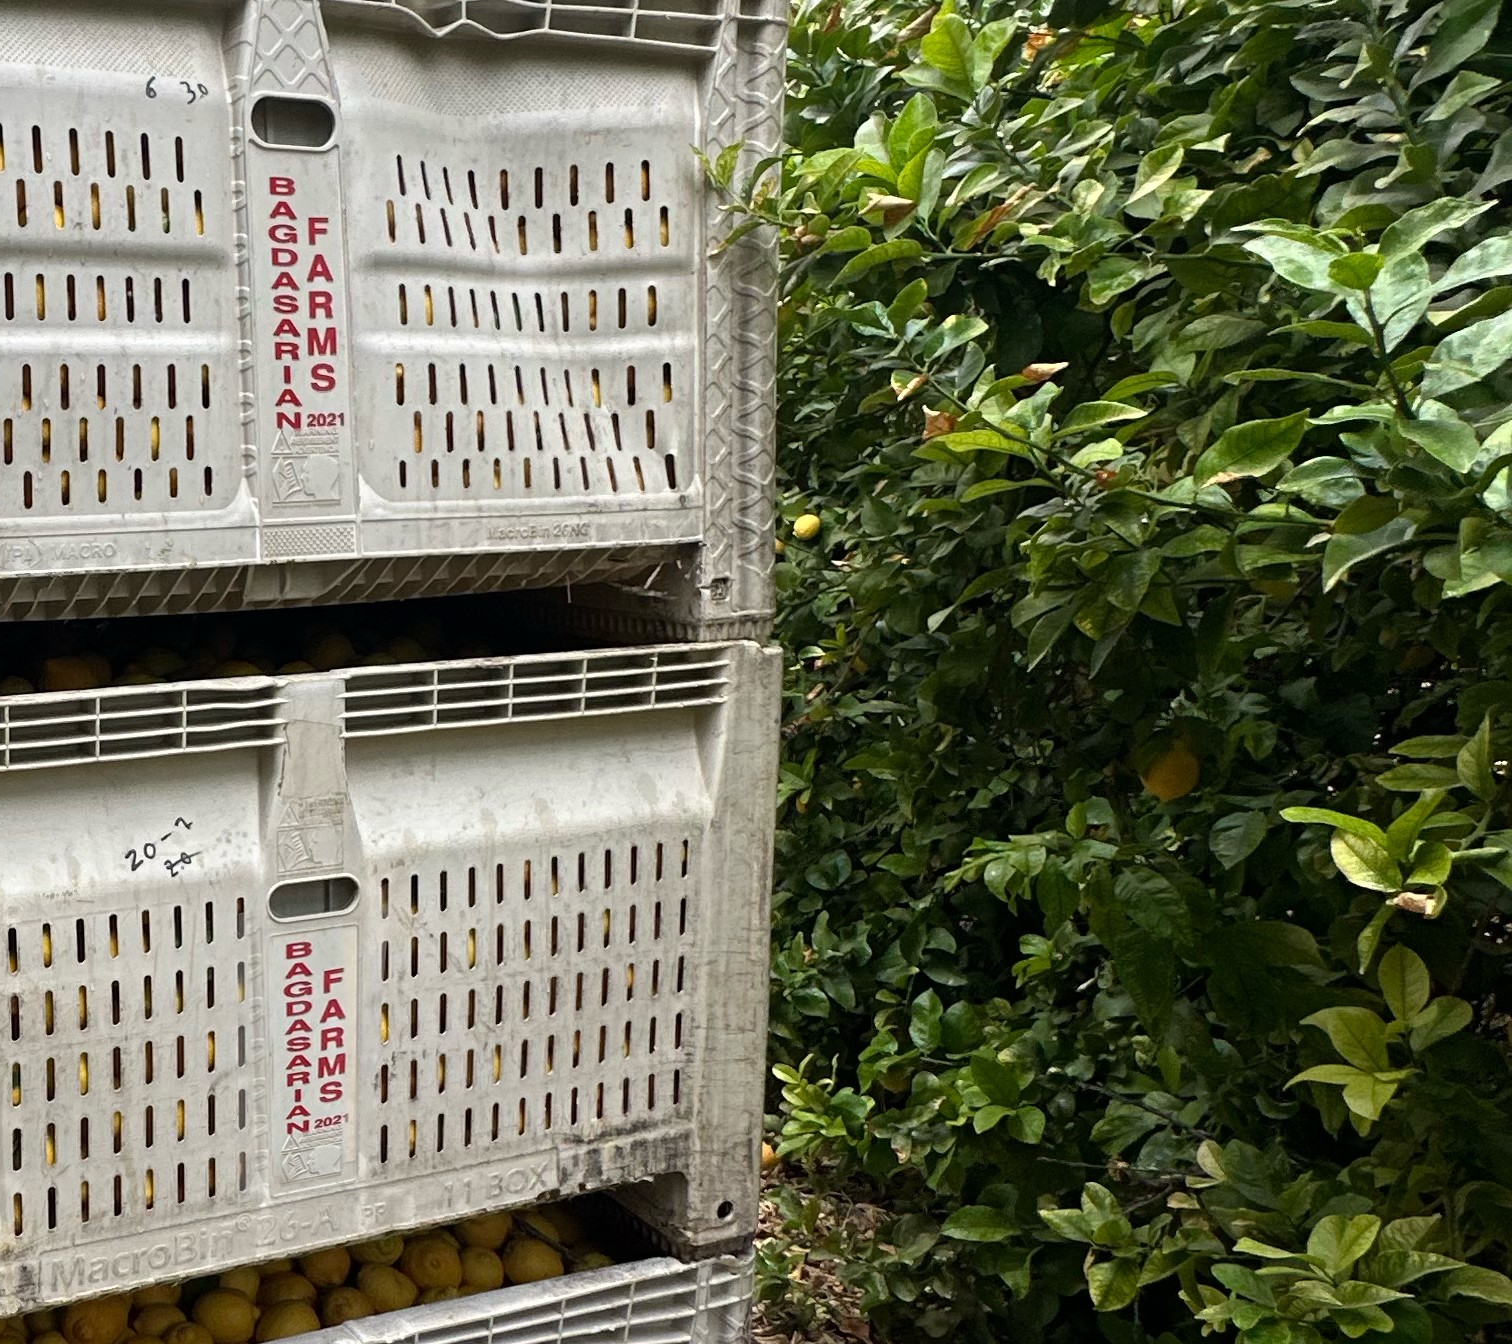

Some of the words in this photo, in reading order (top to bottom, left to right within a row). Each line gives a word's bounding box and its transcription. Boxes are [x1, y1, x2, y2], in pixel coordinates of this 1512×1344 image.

[267, 175, 303, 431] BAGDASARIAN
[306, 216, 338, 393] FARMS
[307, 412, 346, 428] 2021
[283, 941, 314, 1135] BAGDASARIAN
[317, 967, 348, 1104] FARMS
[314, 1113, 350, 1130] 2021
[486, 1160, 550, 1199] BOX
